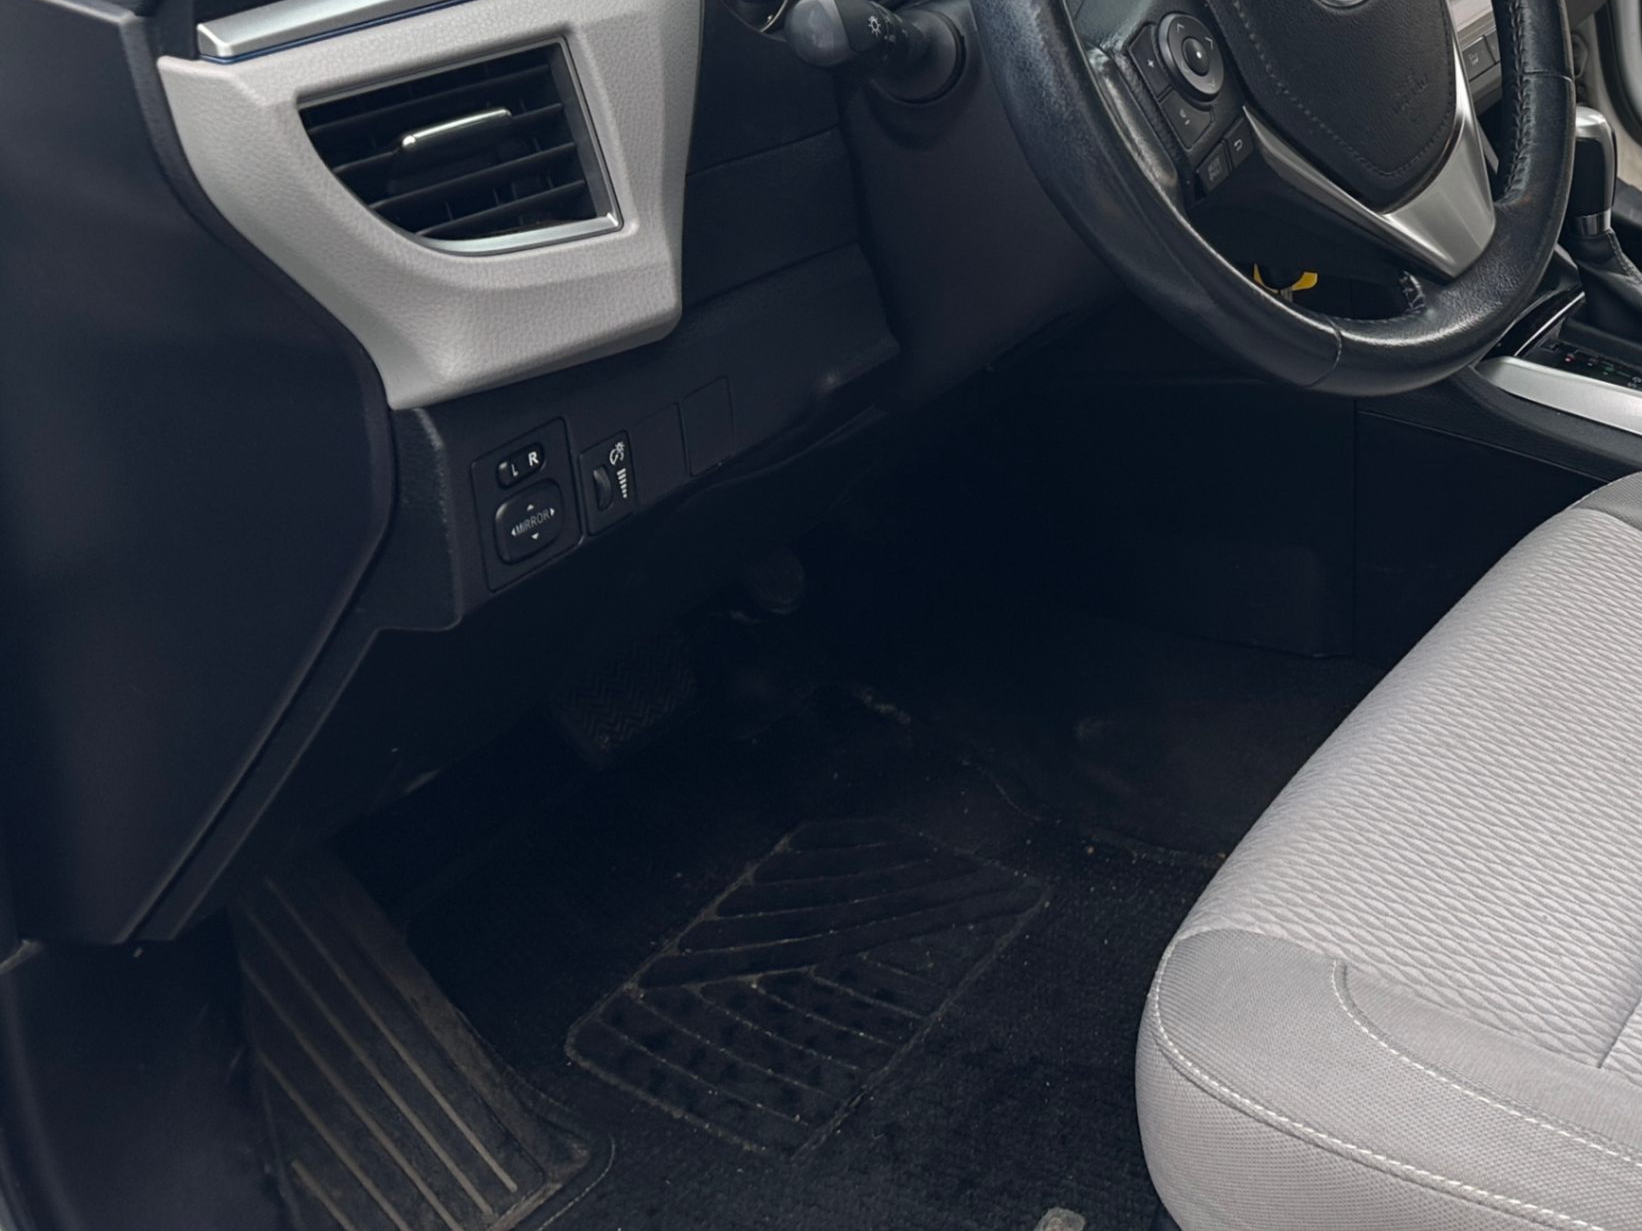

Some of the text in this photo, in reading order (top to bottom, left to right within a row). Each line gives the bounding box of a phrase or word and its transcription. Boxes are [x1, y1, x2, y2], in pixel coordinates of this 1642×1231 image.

[511, 451, 539, 477] L R
[515, 508, 550, 535] MIRROR
